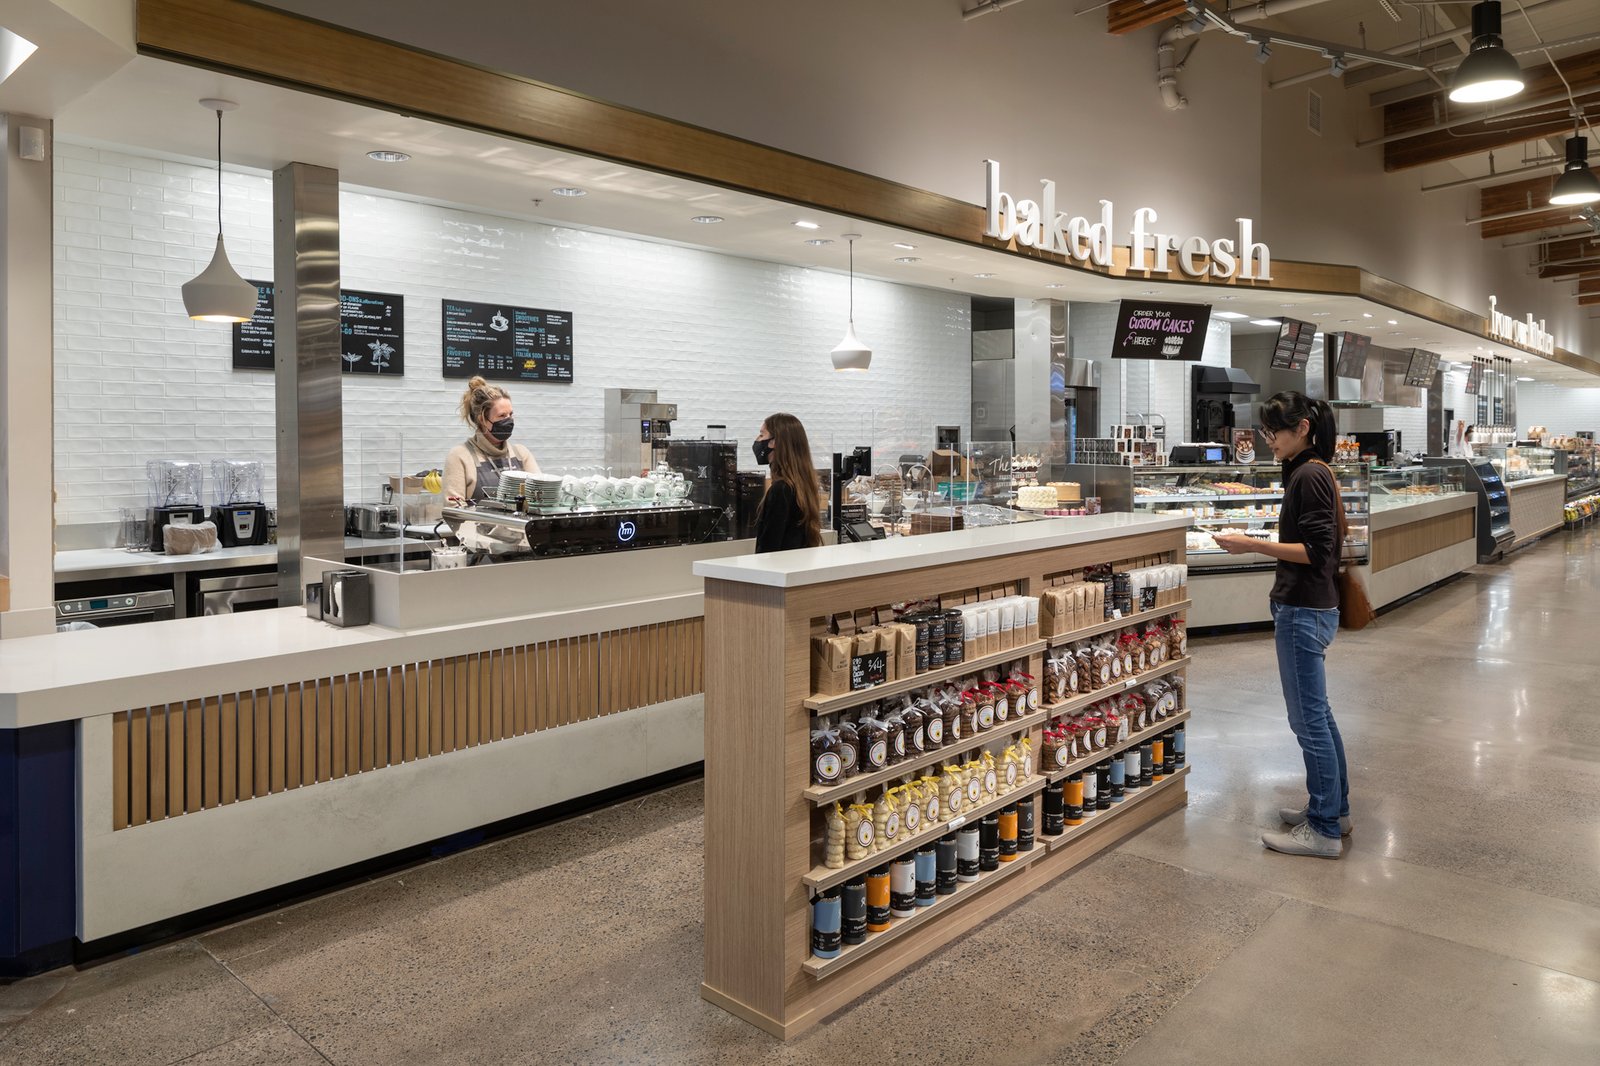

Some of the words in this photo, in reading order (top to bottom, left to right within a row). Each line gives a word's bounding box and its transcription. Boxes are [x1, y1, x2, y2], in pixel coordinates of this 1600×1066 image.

[983, 159, 1114, 267] baked
[1126, 207, 1273, 281] fresh
[1129, 316, 1162, 331] CUSTOM
[1162, 318, 1194, 333] CAKES
